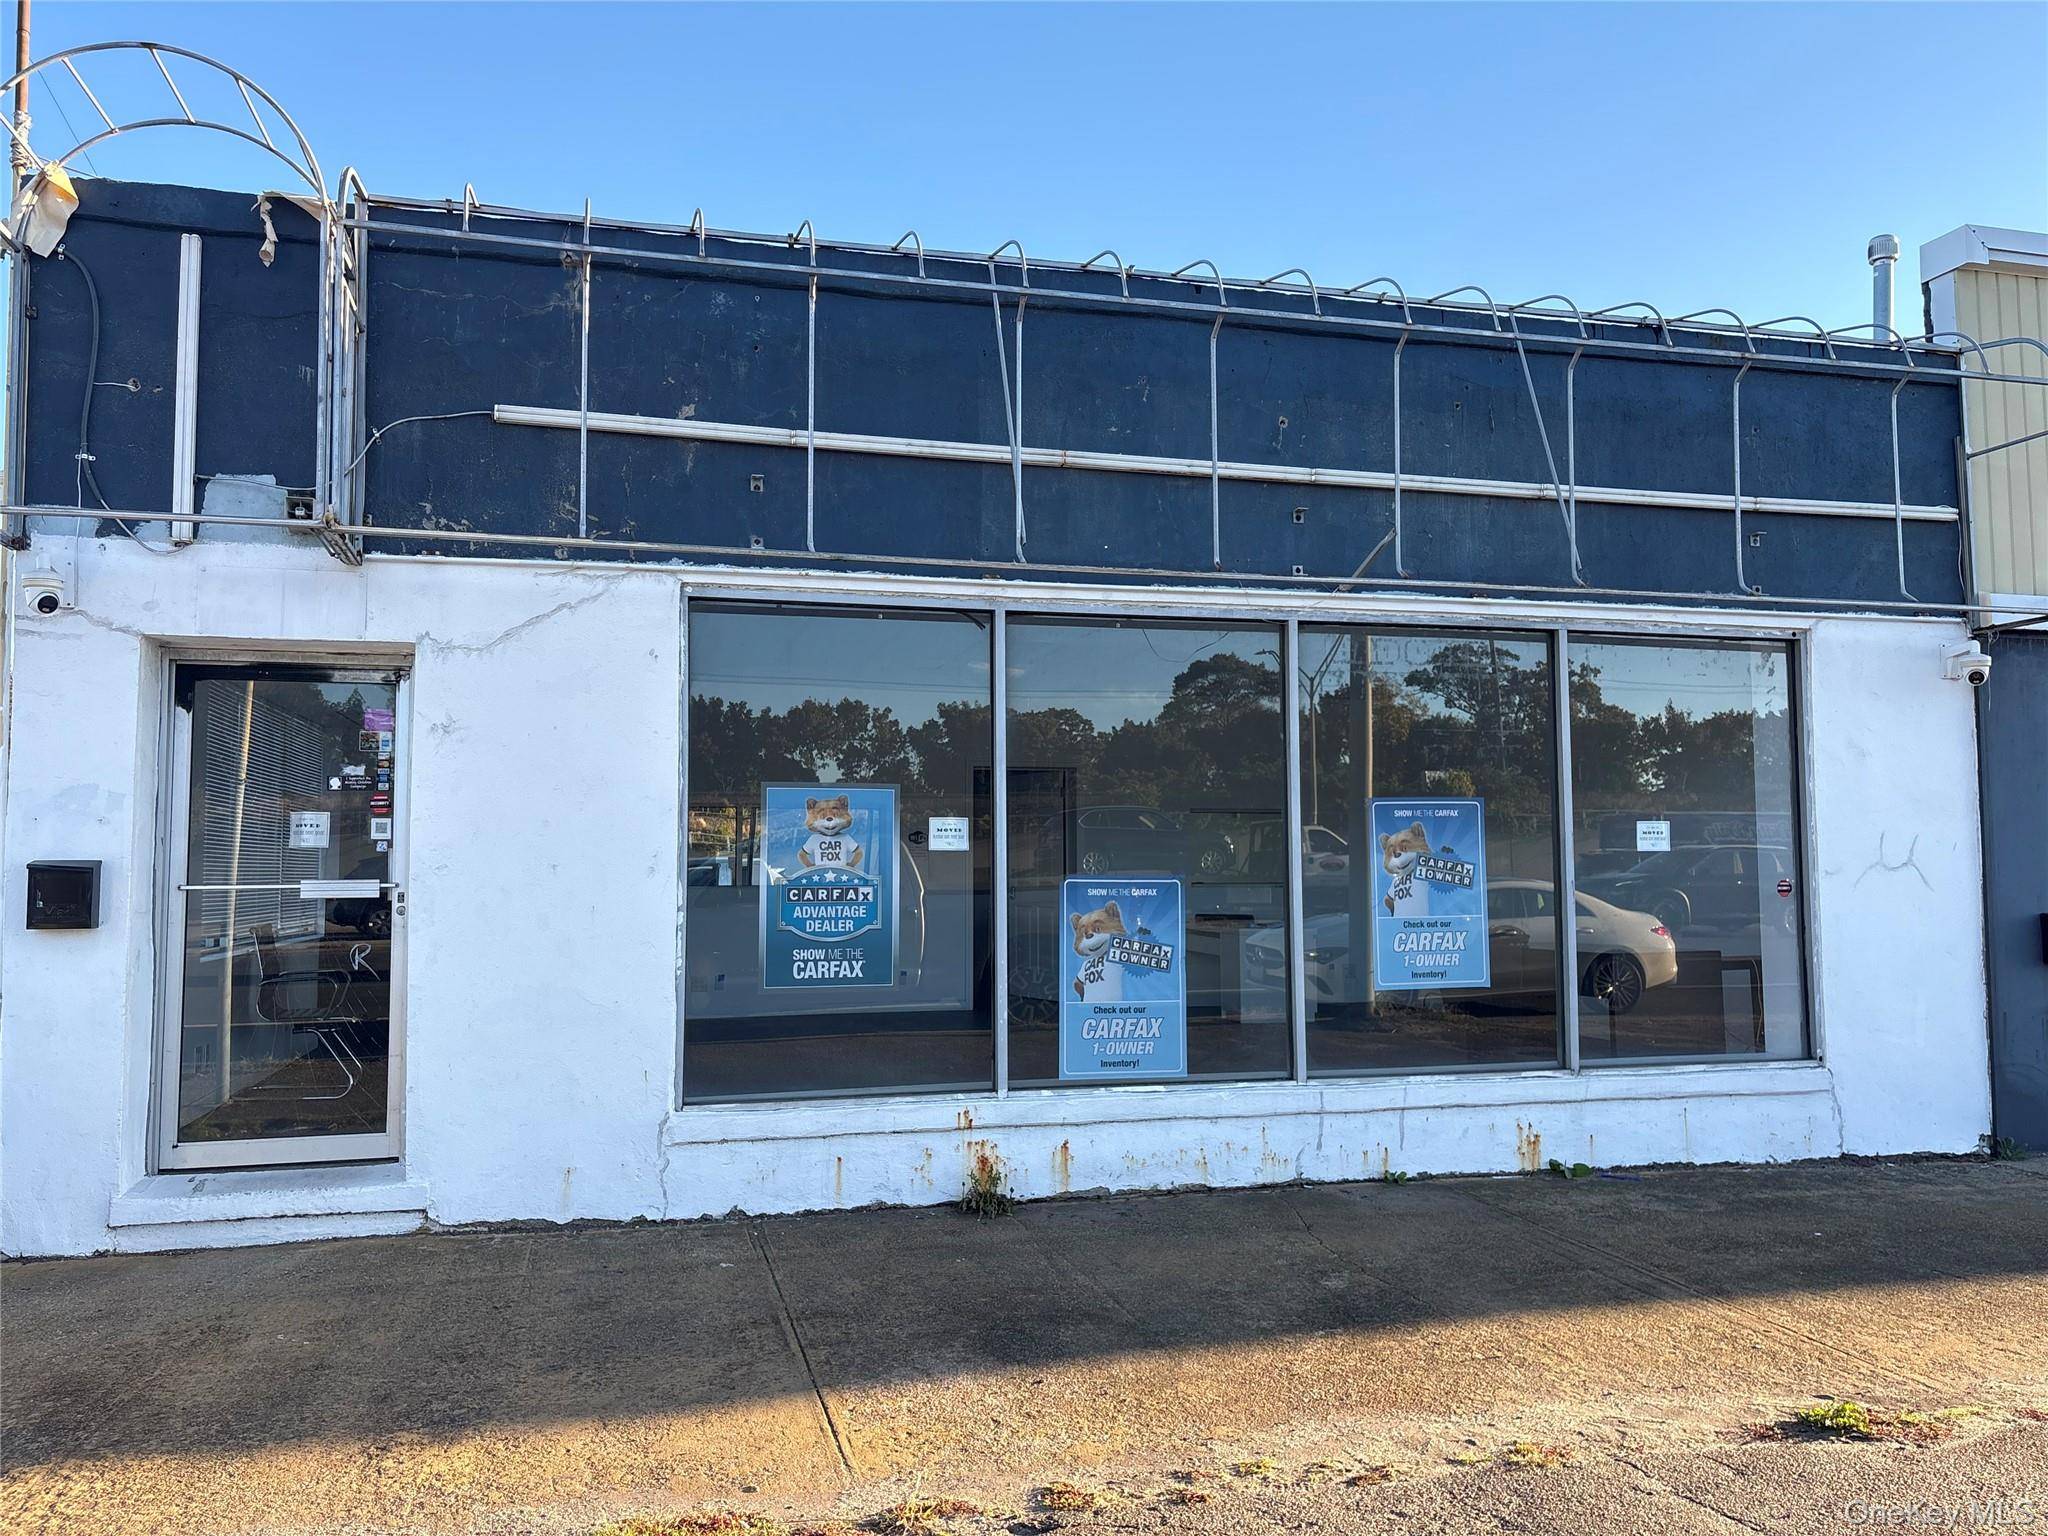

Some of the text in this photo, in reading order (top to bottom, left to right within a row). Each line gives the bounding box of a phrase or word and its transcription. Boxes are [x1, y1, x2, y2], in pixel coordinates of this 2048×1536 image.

[1393, 809, 1459, 817] SHOW ME THE CARFAX
[819, 840, 842, 851] CAR
[820, 851, 842, 862] FOX
[1419, 856, 1472, 876] CARFAX
[788, 889, 872, 902] CARFAX
[1087, 888, 1158, 896] SHOW ME THE CARFAX
[1393, 886, 1413, 900] FOX
[793, 905, 867, 919] ADVANTAGE
[806, 919, 854, 932] DEALER
[1403, 920, 1425, 929] Check
[1113, 938, 1171, 959] CARFAX
[1393, 931, 1469, 953] CARFAX
[792, 947, 864, 961] SHOW ME THE
[1404, 953, 1460, 967] 1-OWNER
[792, 960, 864, 979] CARFAX
[1084, 956, 1105, 972] CAR
[1084, 969, 1105, 985] FOX
[1411, 970, 1447, 980] Inventory!
[1093, 1006, 1117, 1014] Check
[1118, 1006, 1132, 1014] out
[1081, 1017, 1164, 1040] CARFAX
[1093, 1041, 1154, 1056] 1-OWNER
[1100, 1059, 1140, 1069] Inventory!
